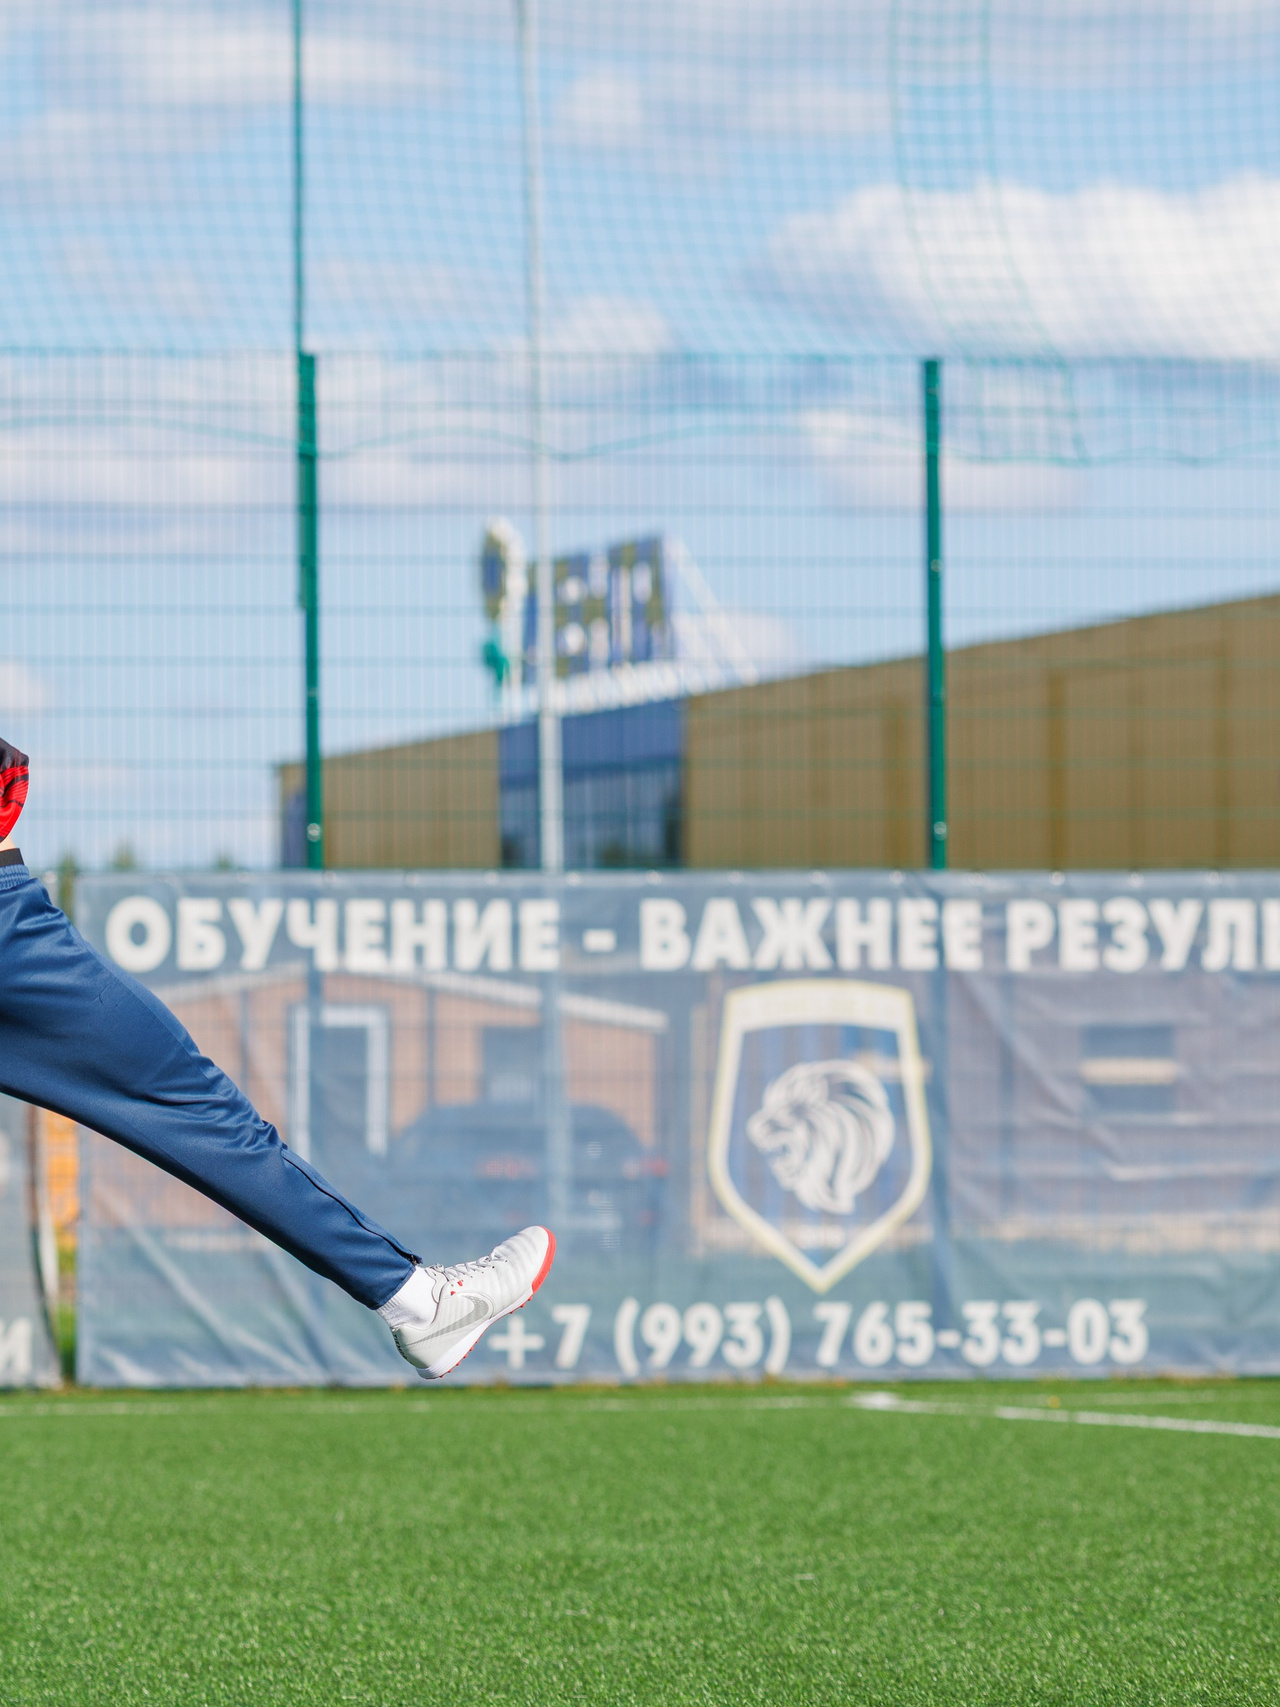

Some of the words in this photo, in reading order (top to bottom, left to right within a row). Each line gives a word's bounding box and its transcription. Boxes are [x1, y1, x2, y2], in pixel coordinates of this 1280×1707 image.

[105, 895, 561, 972] ОБУЧЕНИЕ
[638, 896, 984, 972] ВАЖНЕЕ
[614, 1296, 791, 1377] (993)
[813, 1300, 1150, 1368] 765-33-03
